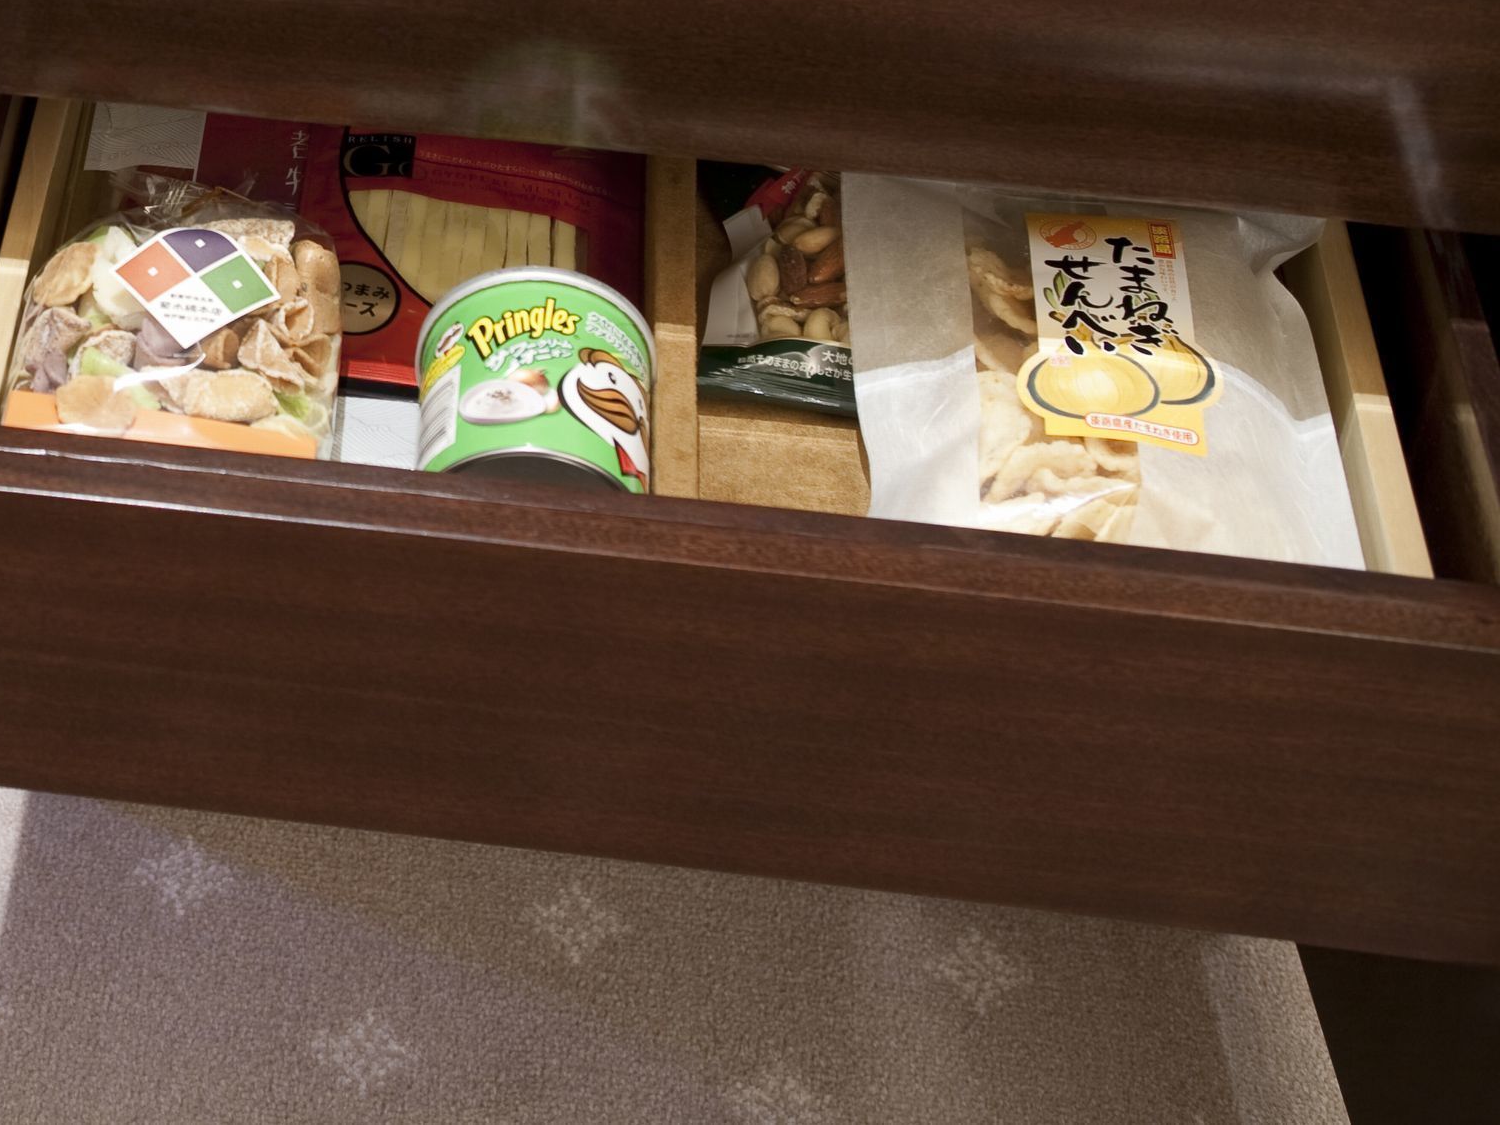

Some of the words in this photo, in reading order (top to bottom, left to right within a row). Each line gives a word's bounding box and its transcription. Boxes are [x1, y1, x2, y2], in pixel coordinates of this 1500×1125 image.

[466, 297, 581, 360] Pringles
[1044, 255, 1119, 355] せんべい
[1104, 237, 1180, 356] たまねぎ
